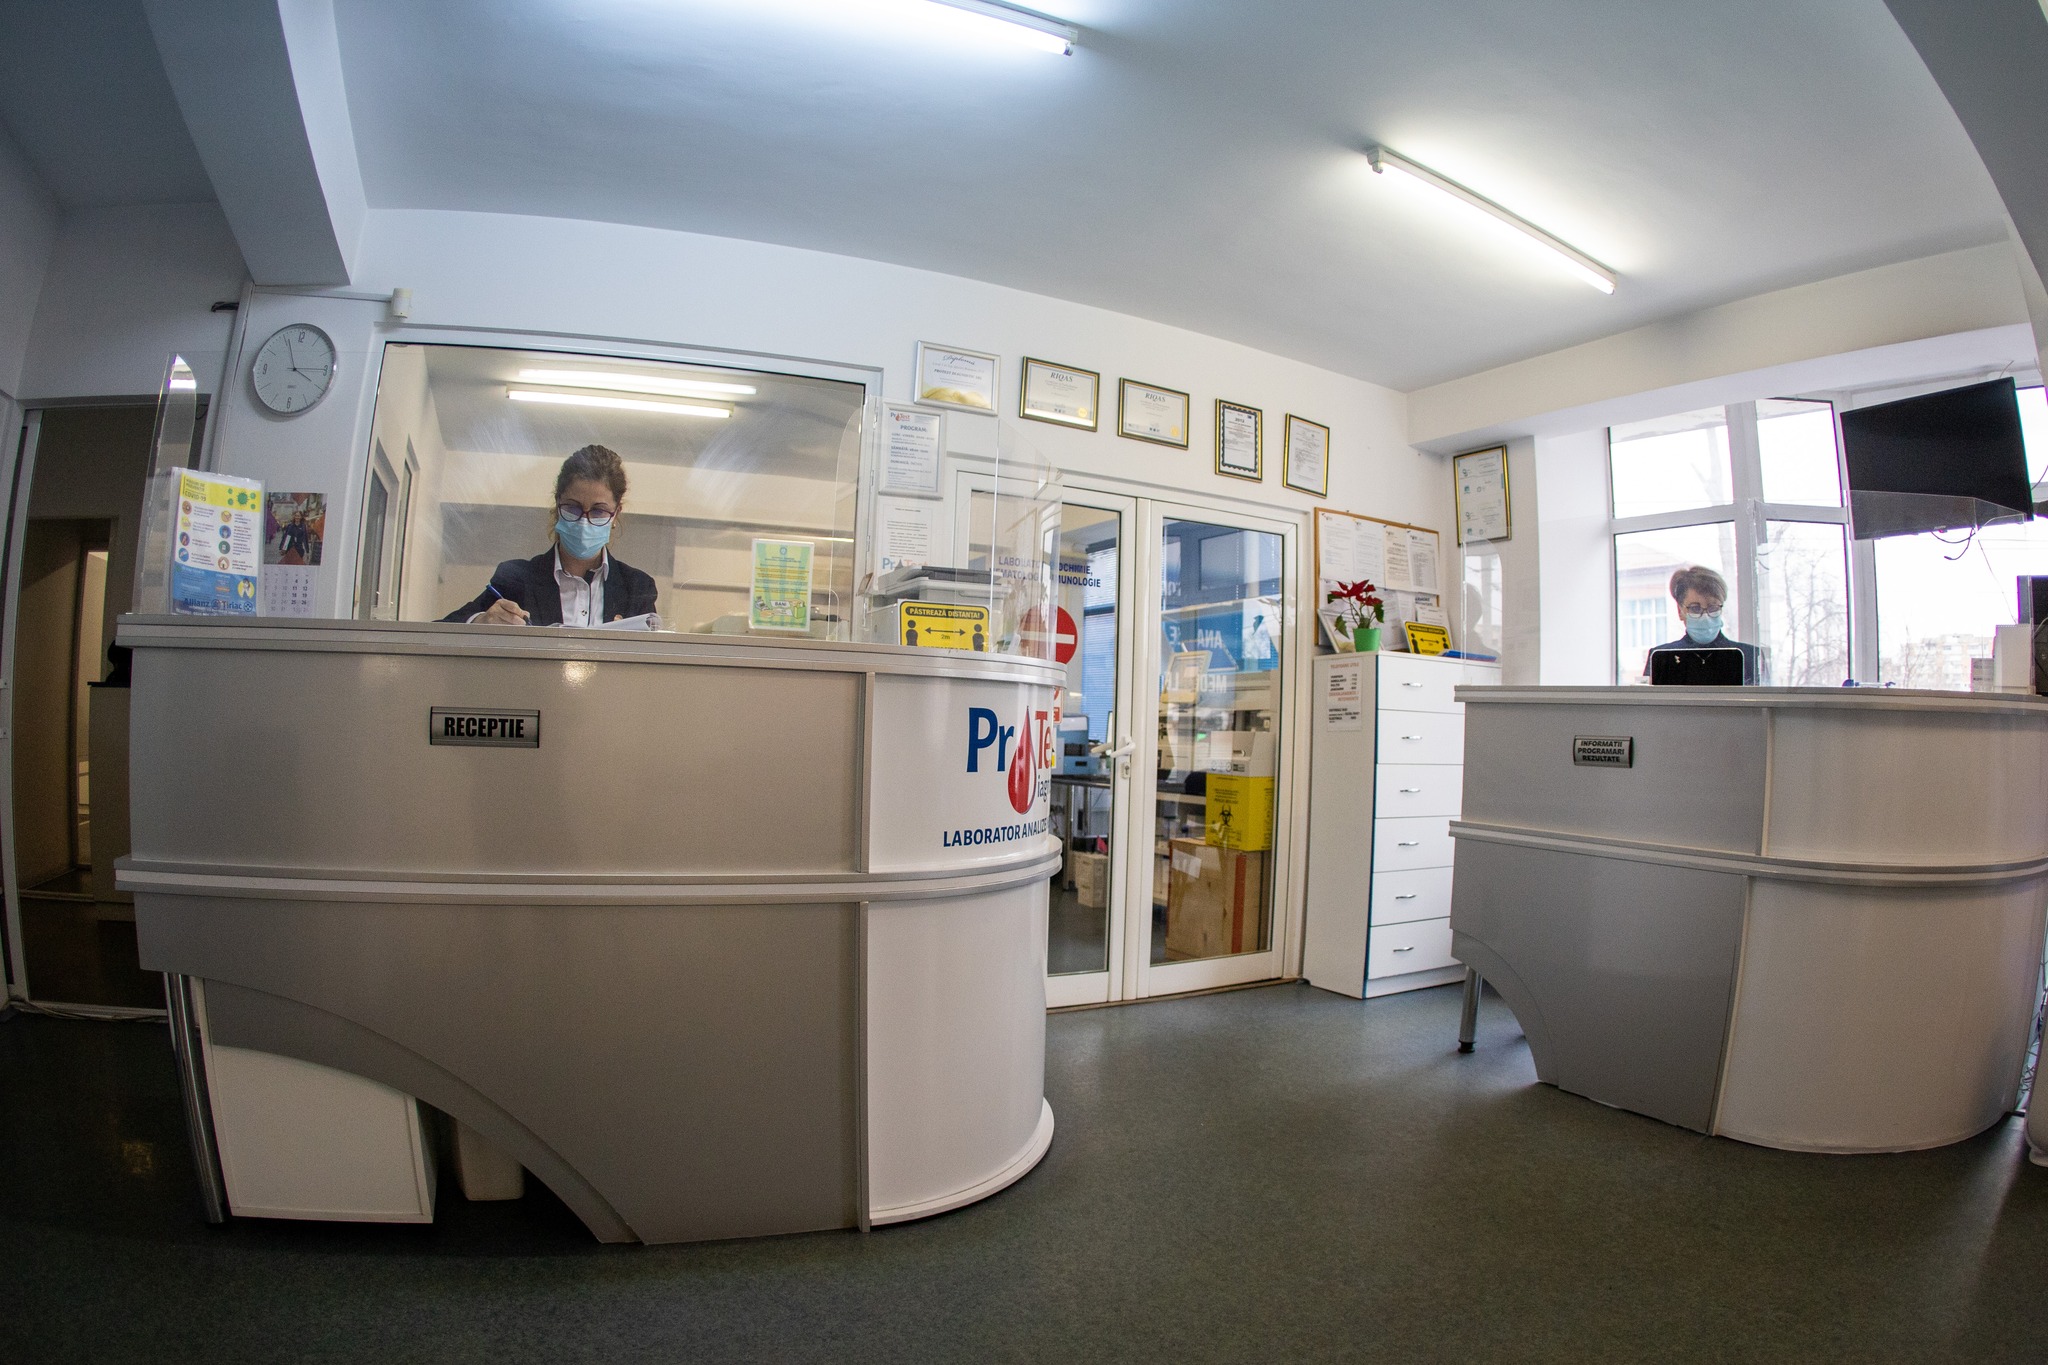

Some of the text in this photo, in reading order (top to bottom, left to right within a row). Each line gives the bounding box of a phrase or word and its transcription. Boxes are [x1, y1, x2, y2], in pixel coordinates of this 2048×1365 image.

[298, 331, 306, 343] 12
[263, 363, 268, 375] 9
[322, 364, 329, 376] 3
[1050, 372, 1074, 382] RIQAS
[287, 397, 292, 409] 6
[1145, 393, 1167, 403] RIQAS
[444, 716, 525, 739] RECEPTIE
[1580, 740, 1623, 748] INFORMATII
[1577, 747, 1625, 755] PROGRAMARI
[1582, 755, 1621, 763] REZULTATE
[943, 825, 1021, 847] LABORATOR
